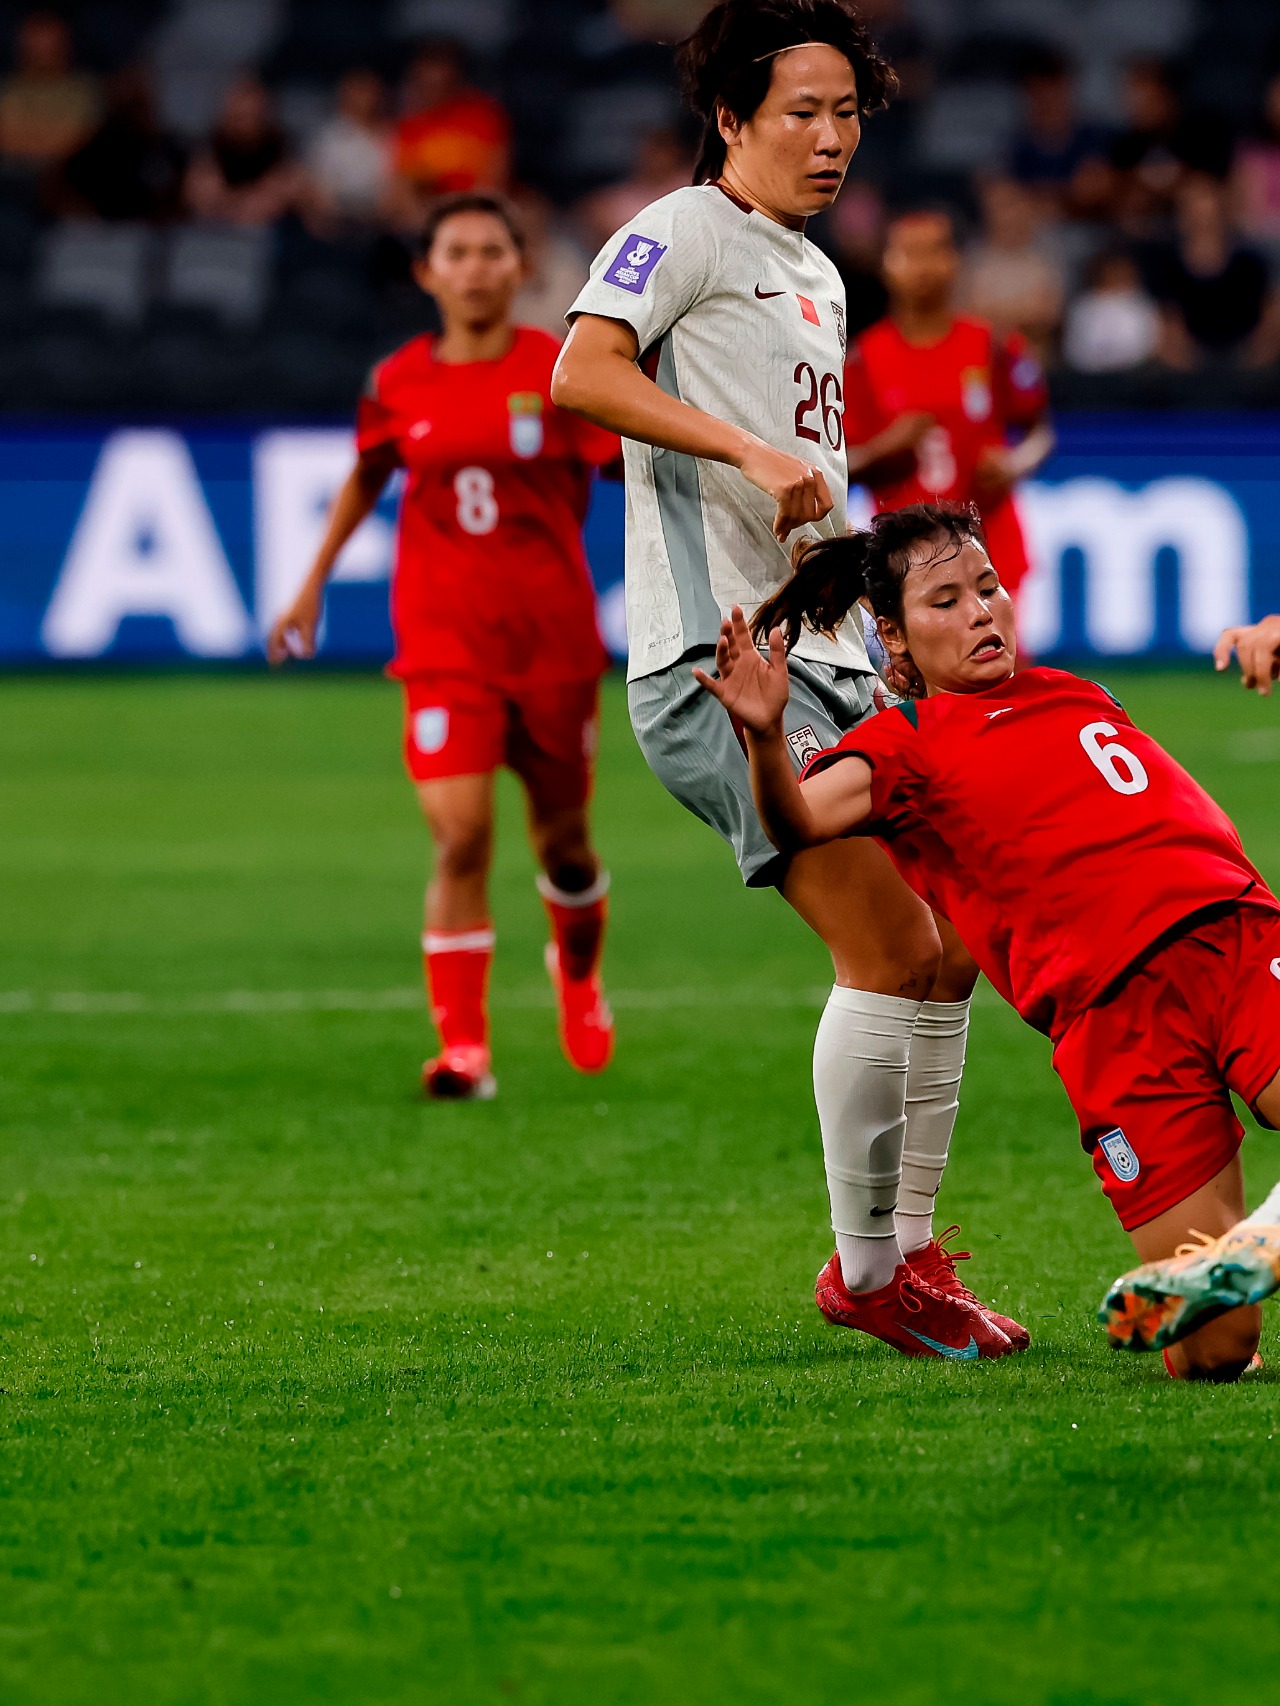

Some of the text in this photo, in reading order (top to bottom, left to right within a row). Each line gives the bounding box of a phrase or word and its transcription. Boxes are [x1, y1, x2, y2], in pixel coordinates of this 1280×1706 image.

[793, 362, 843, 451] 26
[453, 465, 498, 536] 8
[789, 728, 813, 746] CFA
[1078, 721, 1149, 795] 6
